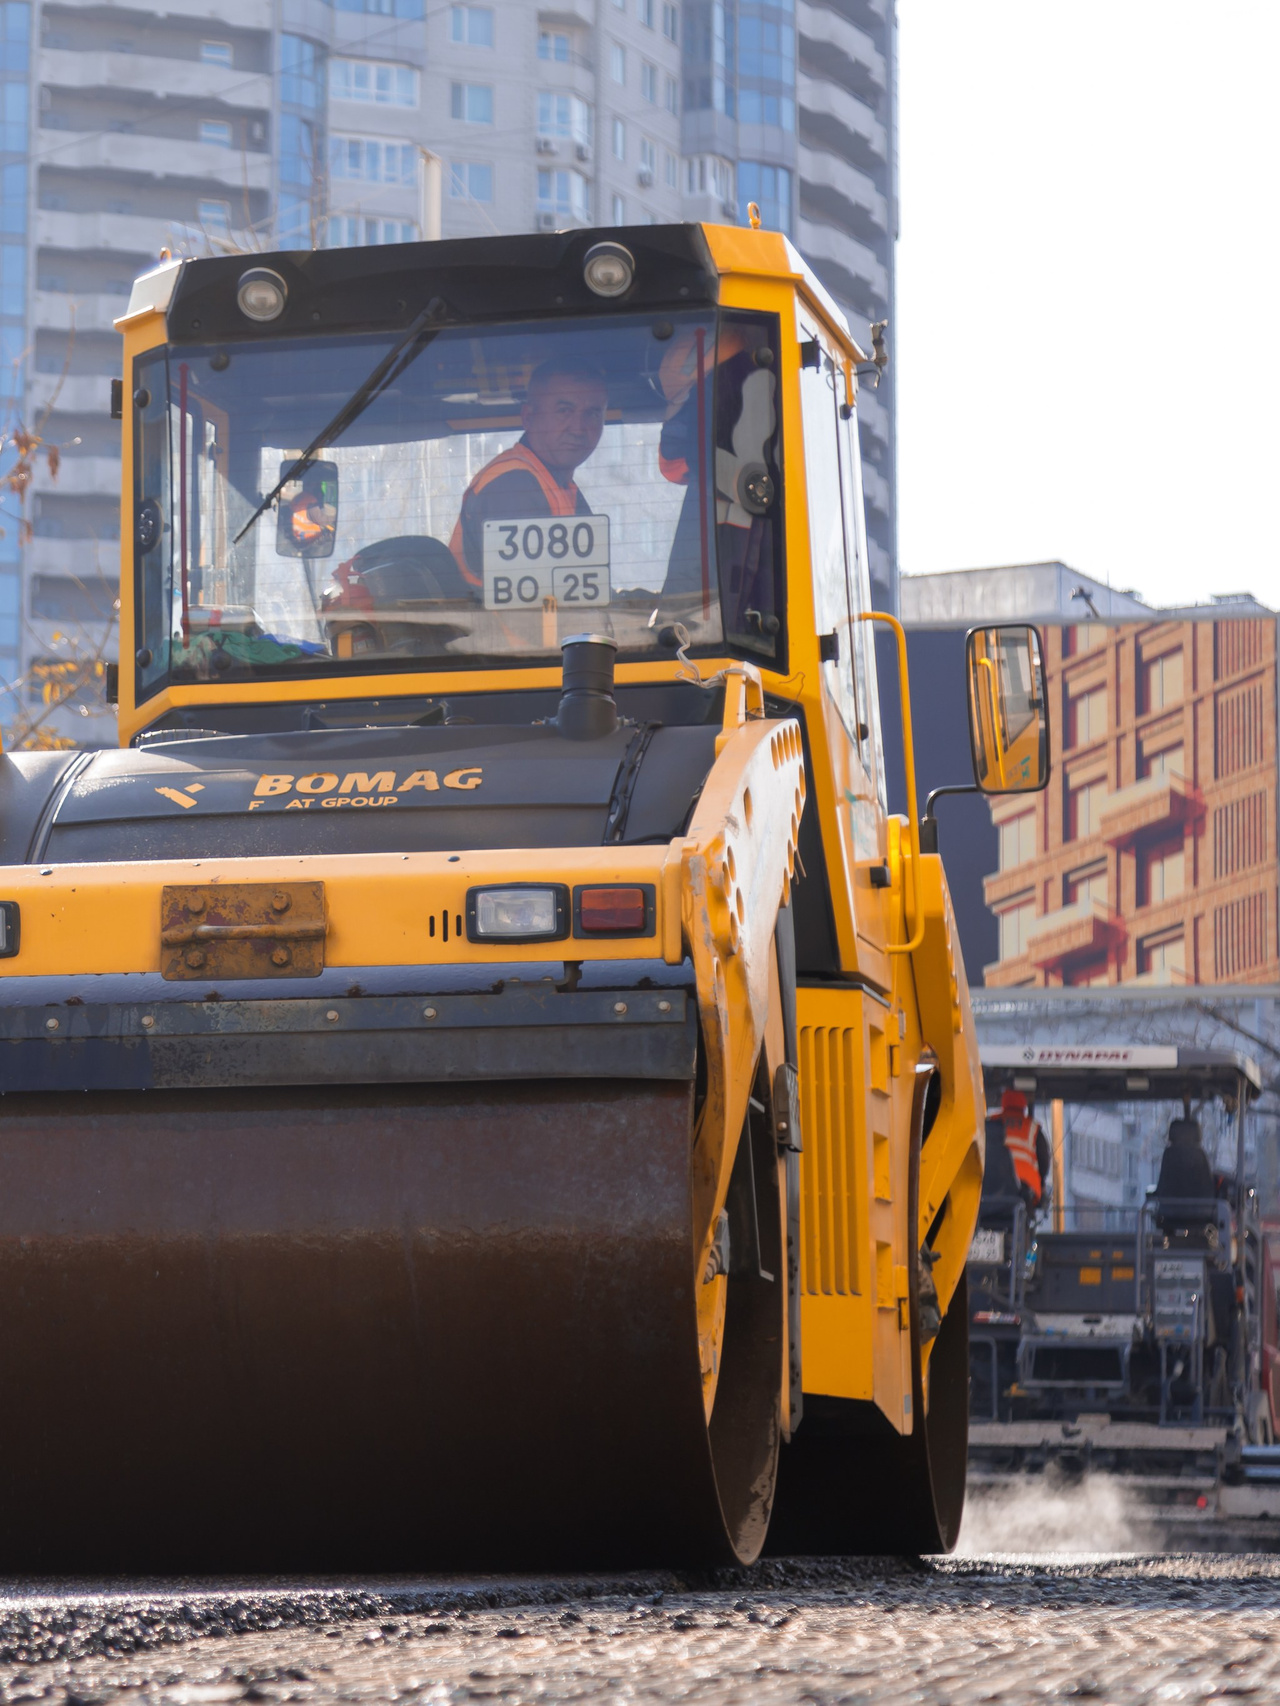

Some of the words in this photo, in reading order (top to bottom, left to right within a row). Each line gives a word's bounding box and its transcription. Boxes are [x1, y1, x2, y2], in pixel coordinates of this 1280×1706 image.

[498, 522, 594, 560] 3080
[563, 573, 599, 601] 25
[253, 767, 483, 796] BOMAG
